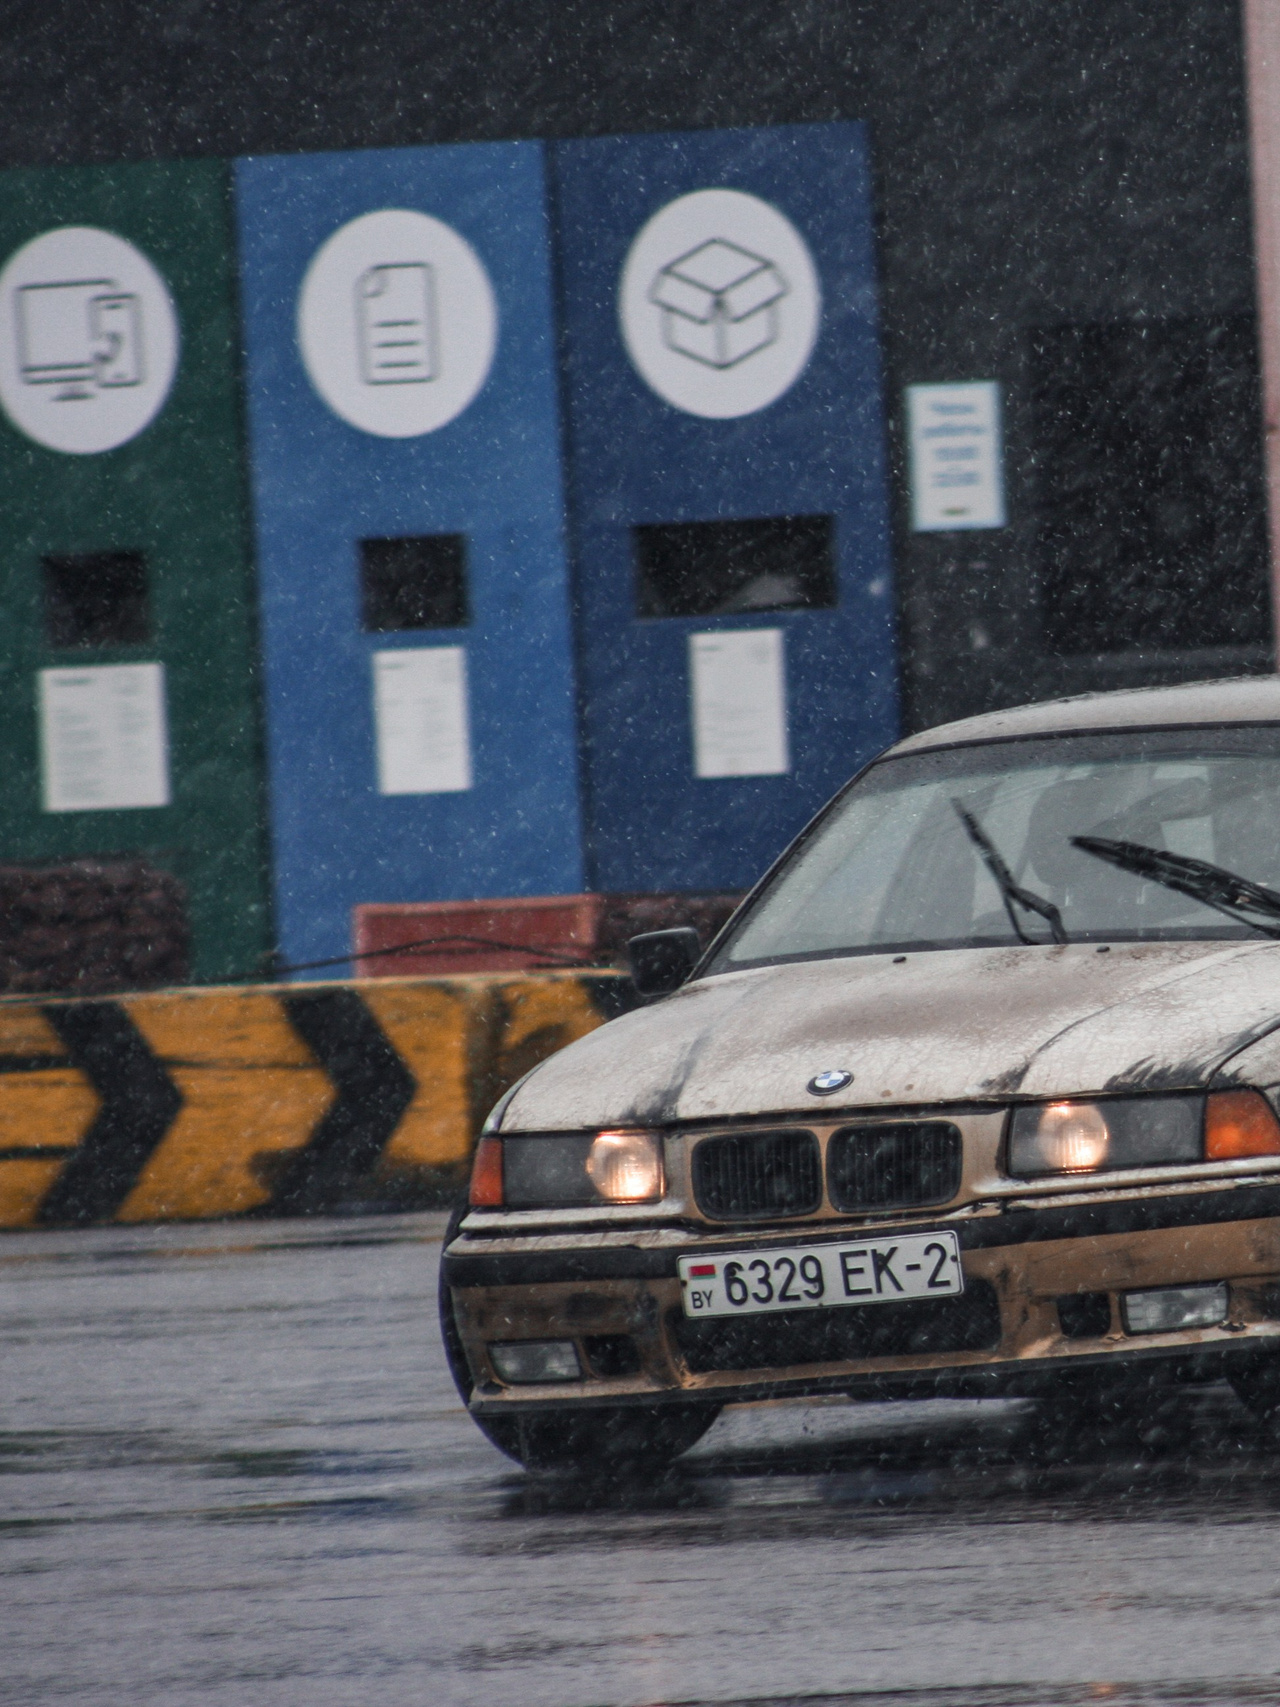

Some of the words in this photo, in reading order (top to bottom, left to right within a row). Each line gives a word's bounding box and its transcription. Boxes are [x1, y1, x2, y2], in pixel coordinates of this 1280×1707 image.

[724, 1254, 825, 1306] 6329
[839, 1242, 952, 1296] EK-2
[691, 1290, 714, 1310] BY
